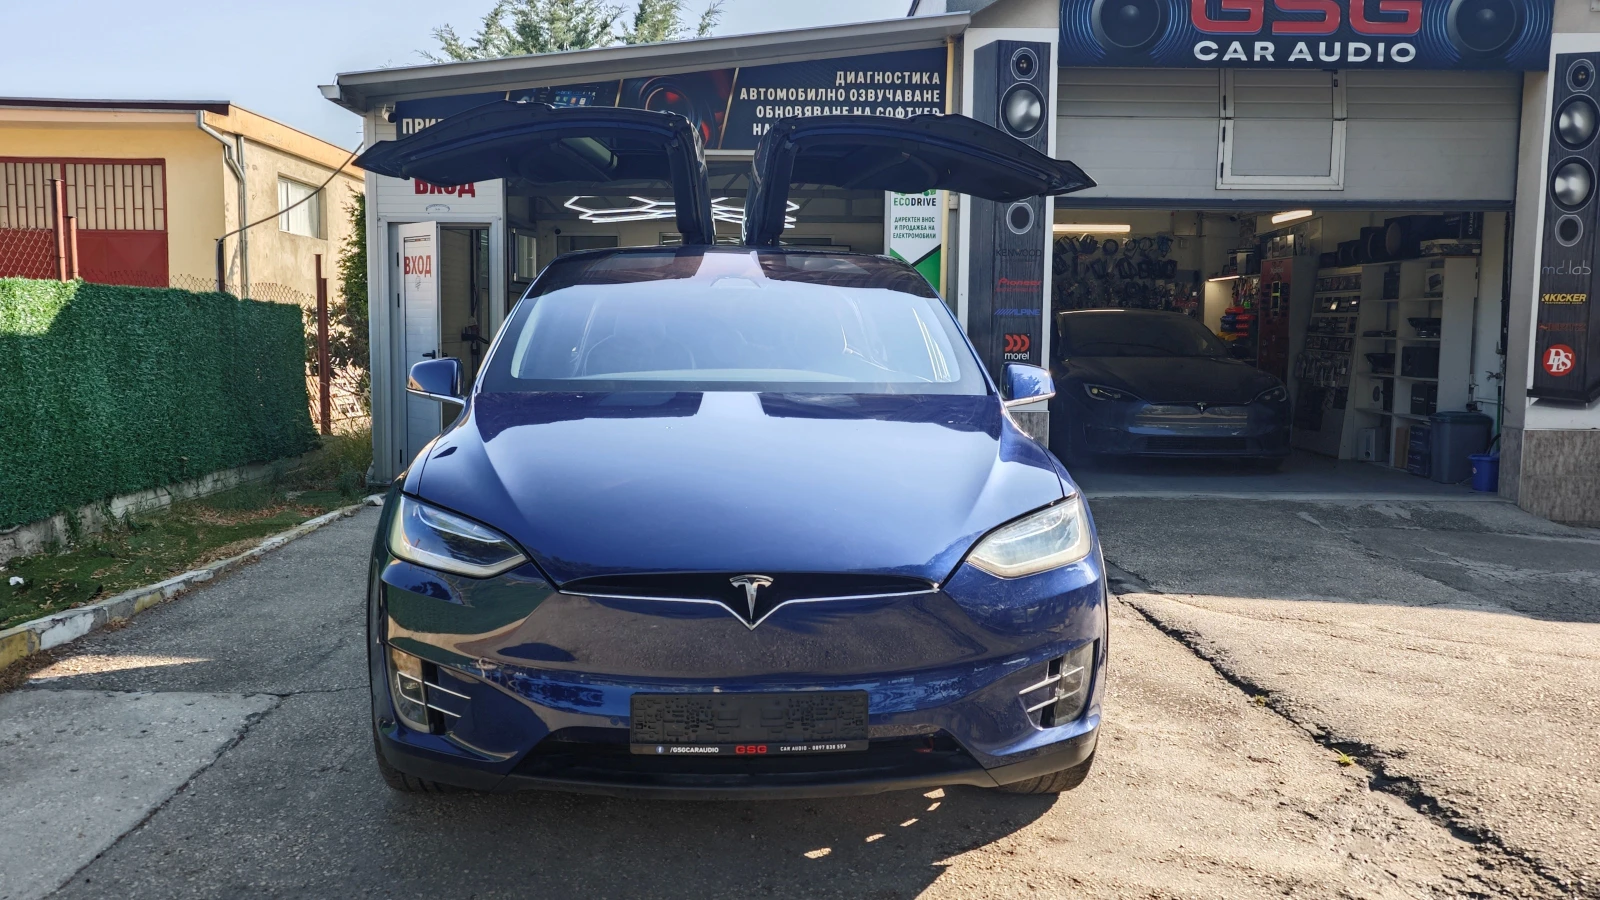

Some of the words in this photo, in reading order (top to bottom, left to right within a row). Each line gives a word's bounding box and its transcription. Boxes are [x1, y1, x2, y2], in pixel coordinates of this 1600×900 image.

[1191, 0, 1422, 35] GSG
[1193, 40, 1275, 62] CAR
[1287, 41, 1416, 63] AUDIO
[835, 71, 940, 86] ДИАГНОСТИКА
[740, 87, 846, 101] АВТОМОБИЛНО
[849, 89, 940, 102] ОЗВУЧАВАНЕ
[756, 105, 849, 118] ОБНОВЯВАНЕ
[853, 106, 871, 115] НА
[876, 106, 940, 118] СОФТУЕР
[893, 198, 937, 206] ECODRIVE
[996, 248, 1042, 256] KENWOOD
[404, 255, 432, 278] ВХОД
[1549, 293, 1587, 302] KICKER
[1011, 308, 1041, 316] ALPINE
[1004, 351, 1030, 360] morel
[736, 745, 767, 753] GSG
